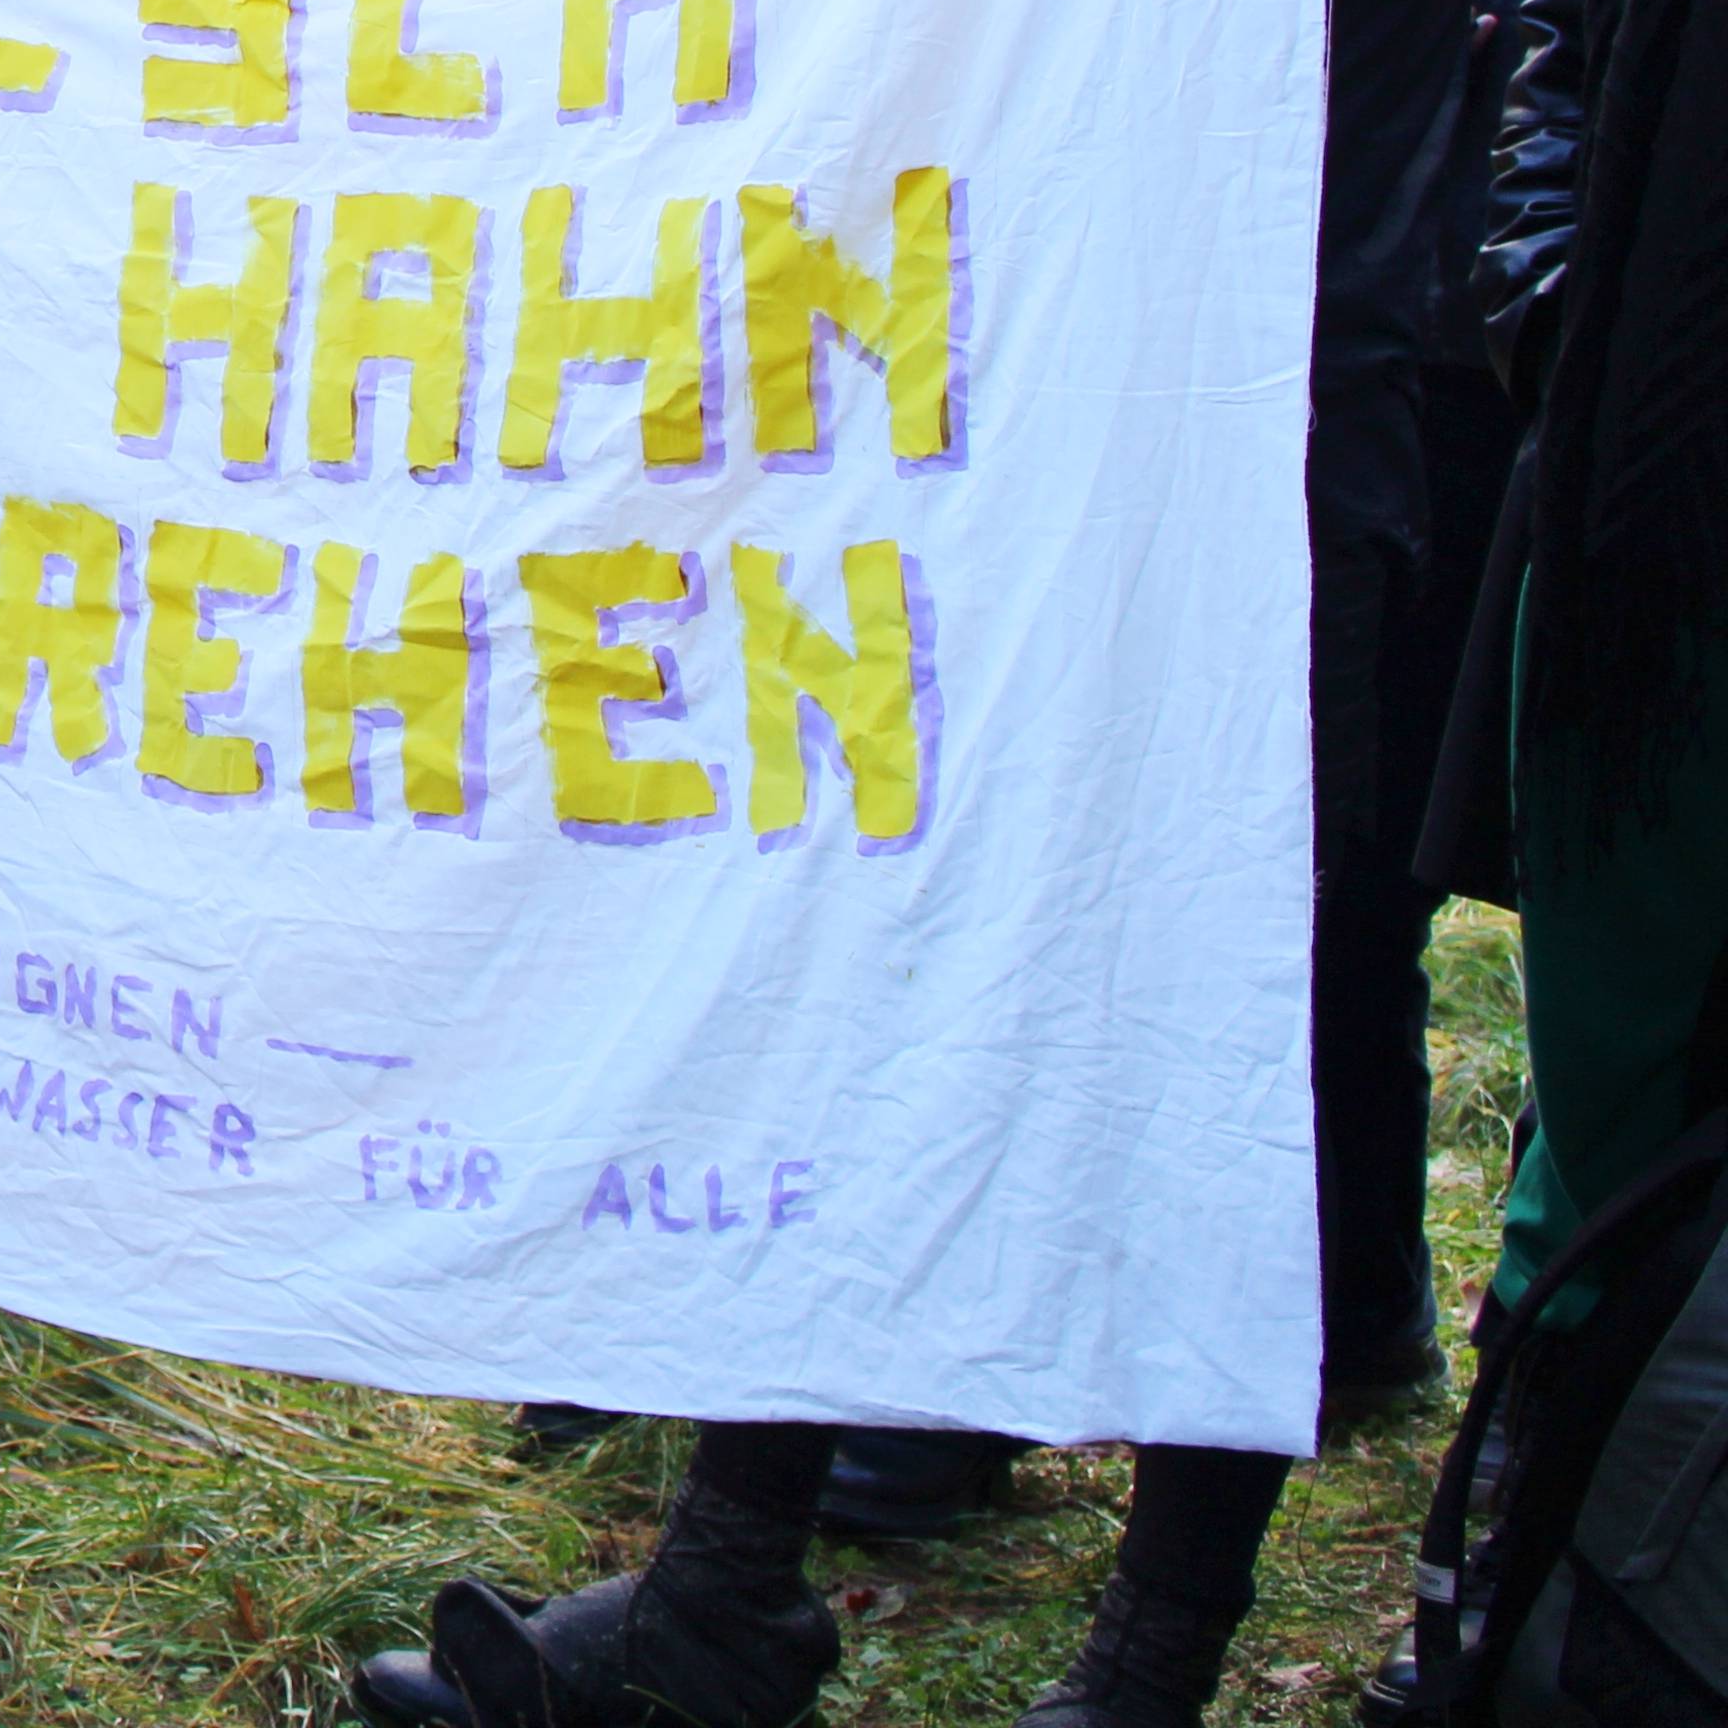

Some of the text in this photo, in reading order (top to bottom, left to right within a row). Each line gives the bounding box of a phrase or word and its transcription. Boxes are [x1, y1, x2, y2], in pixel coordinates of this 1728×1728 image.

[115, 165, 972, 487] HAHN
[358, 1117, 503, 1211] FÜR
[581, 1157, 819, 1235] ALLE
